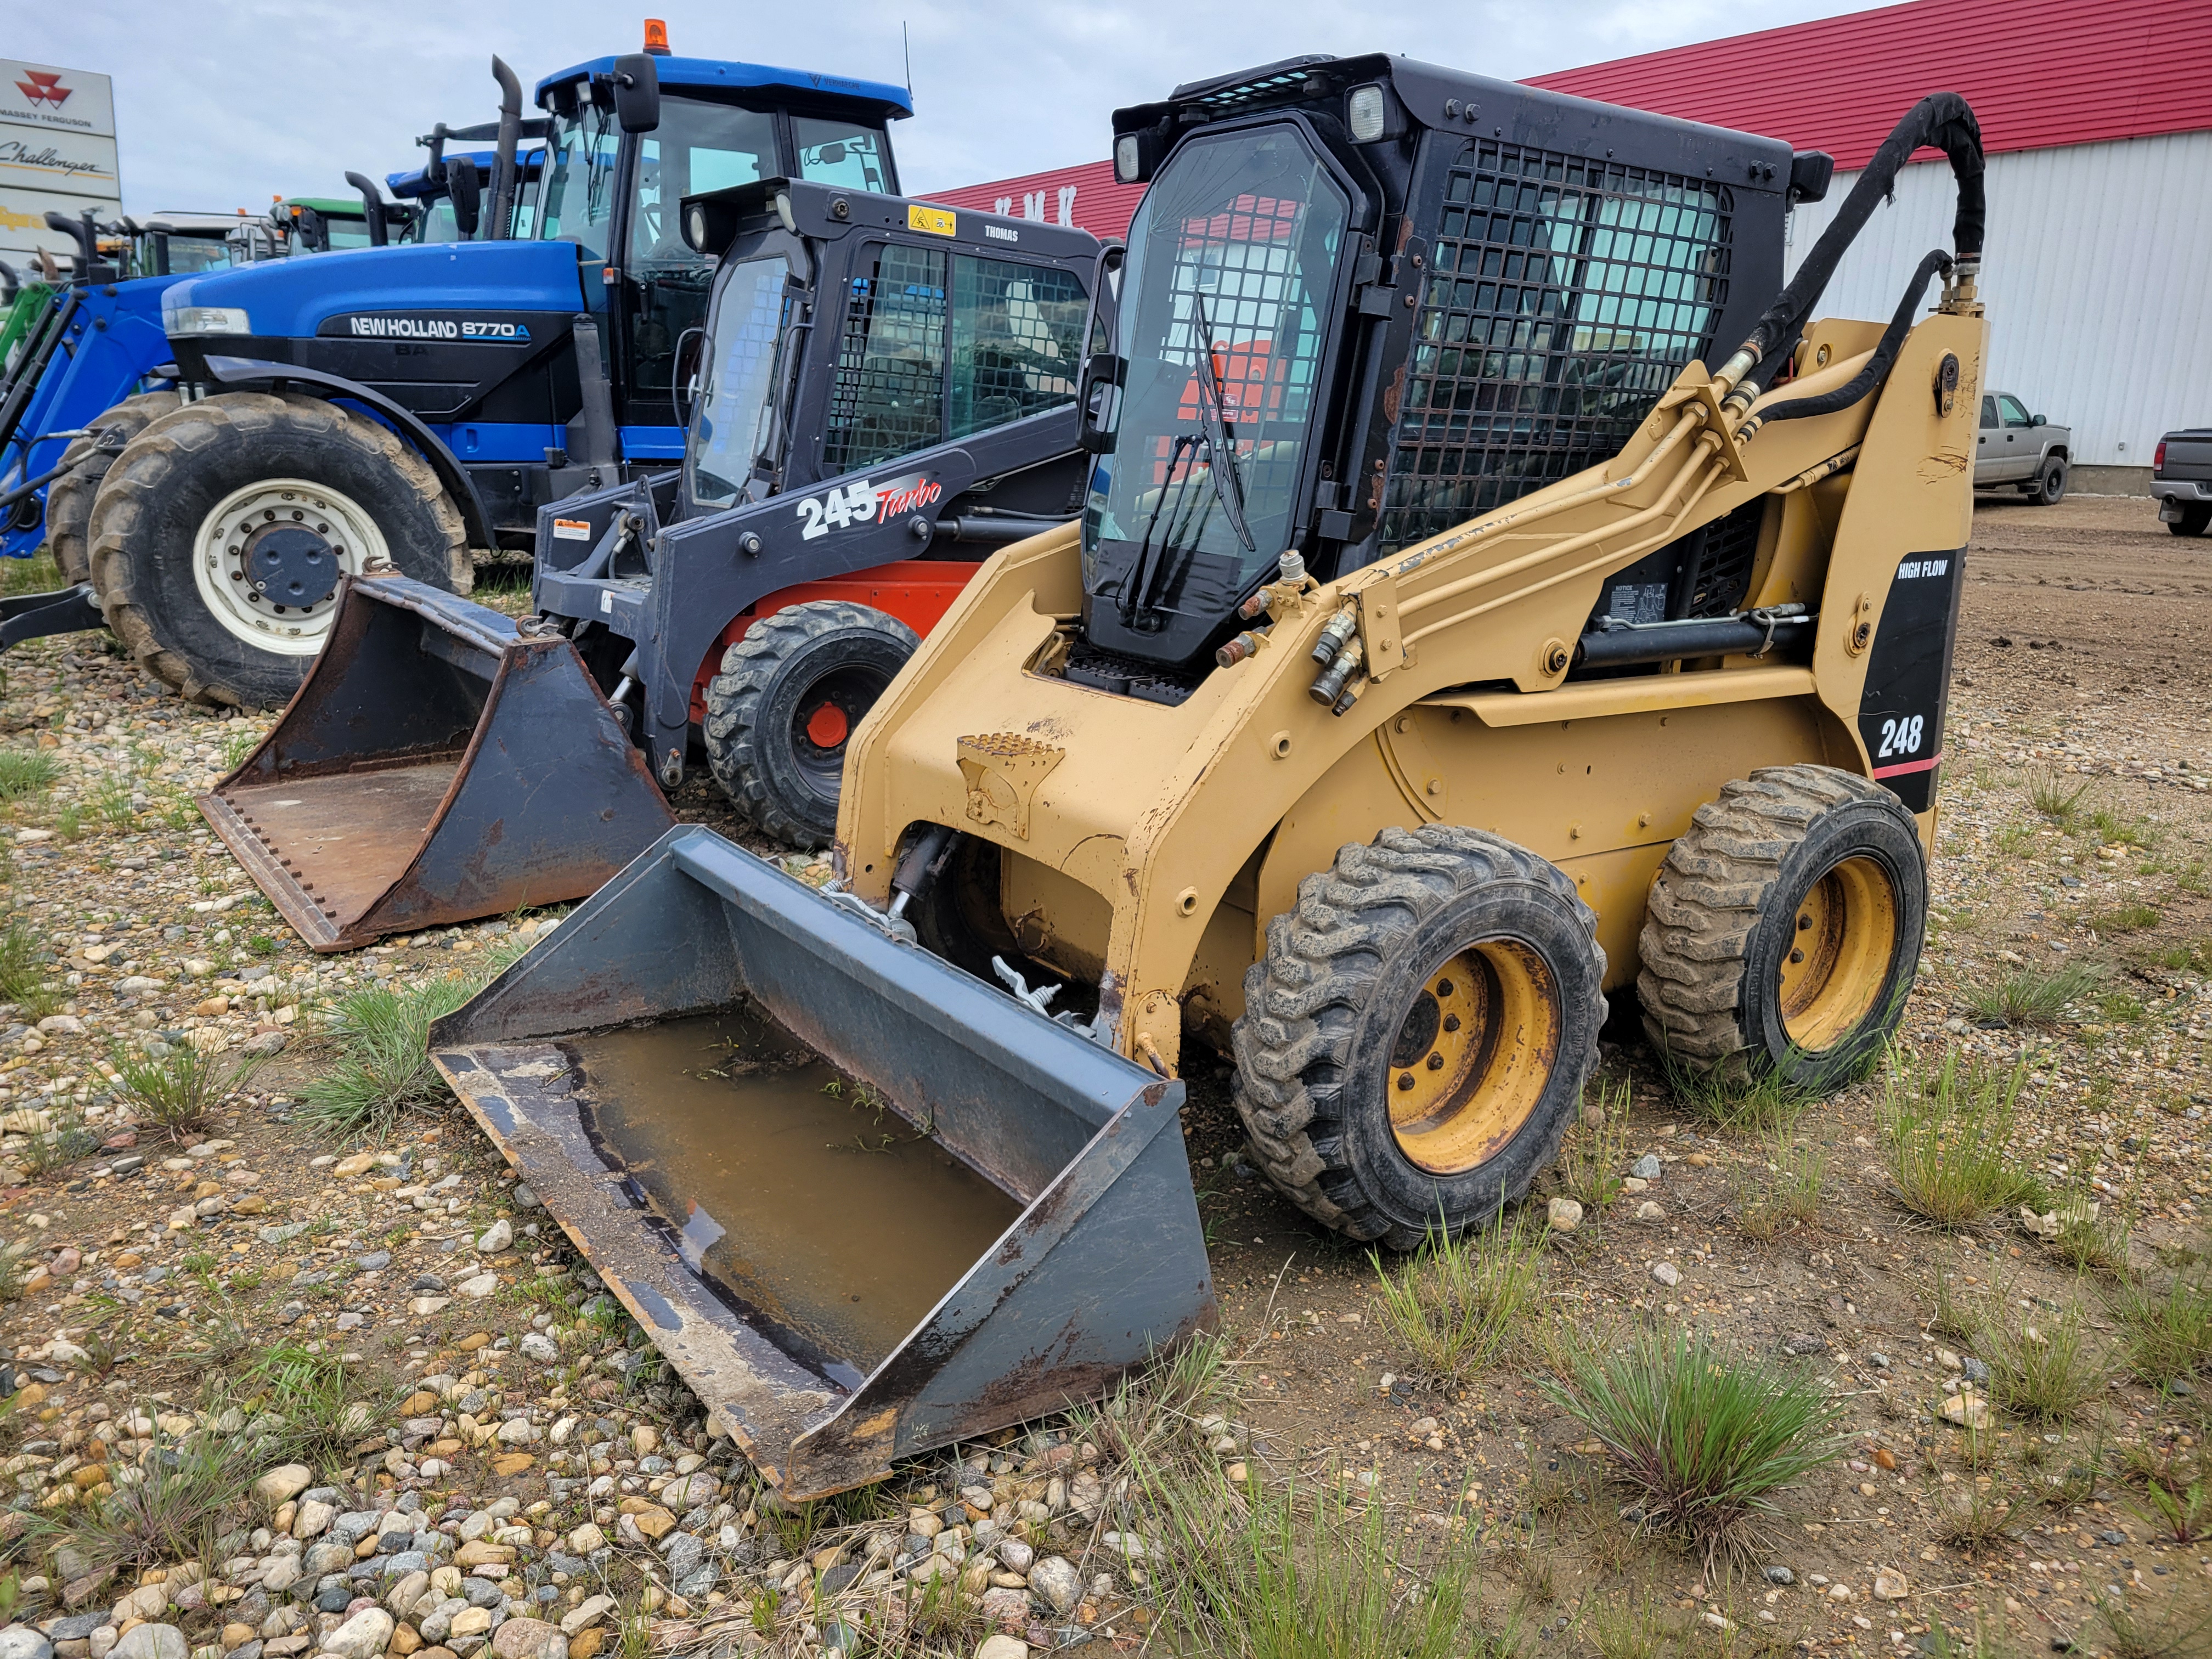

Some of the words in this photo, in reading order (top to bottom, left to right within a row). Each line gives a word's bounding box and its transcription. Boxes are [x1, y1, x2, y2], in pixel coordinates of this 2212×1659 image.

[0, 109, 37, 120] MASSEY
[42, 114, 92, 128] FERGUSON
[0, 141, 114, 176] Challenger
[985, 225, 1019, 242] THOMAS
[351, 317, 385, 335] NEW
[387, 319, 458, 338] HOLLAND
[797, 479, 877, 541] 245
[876, 478, 942, 524] Turbo
[1898, 562, 1921, 579] HIGH
[1921, 560, 1948, 577] FLOW
[1878, 714, 1924, 758] 248
